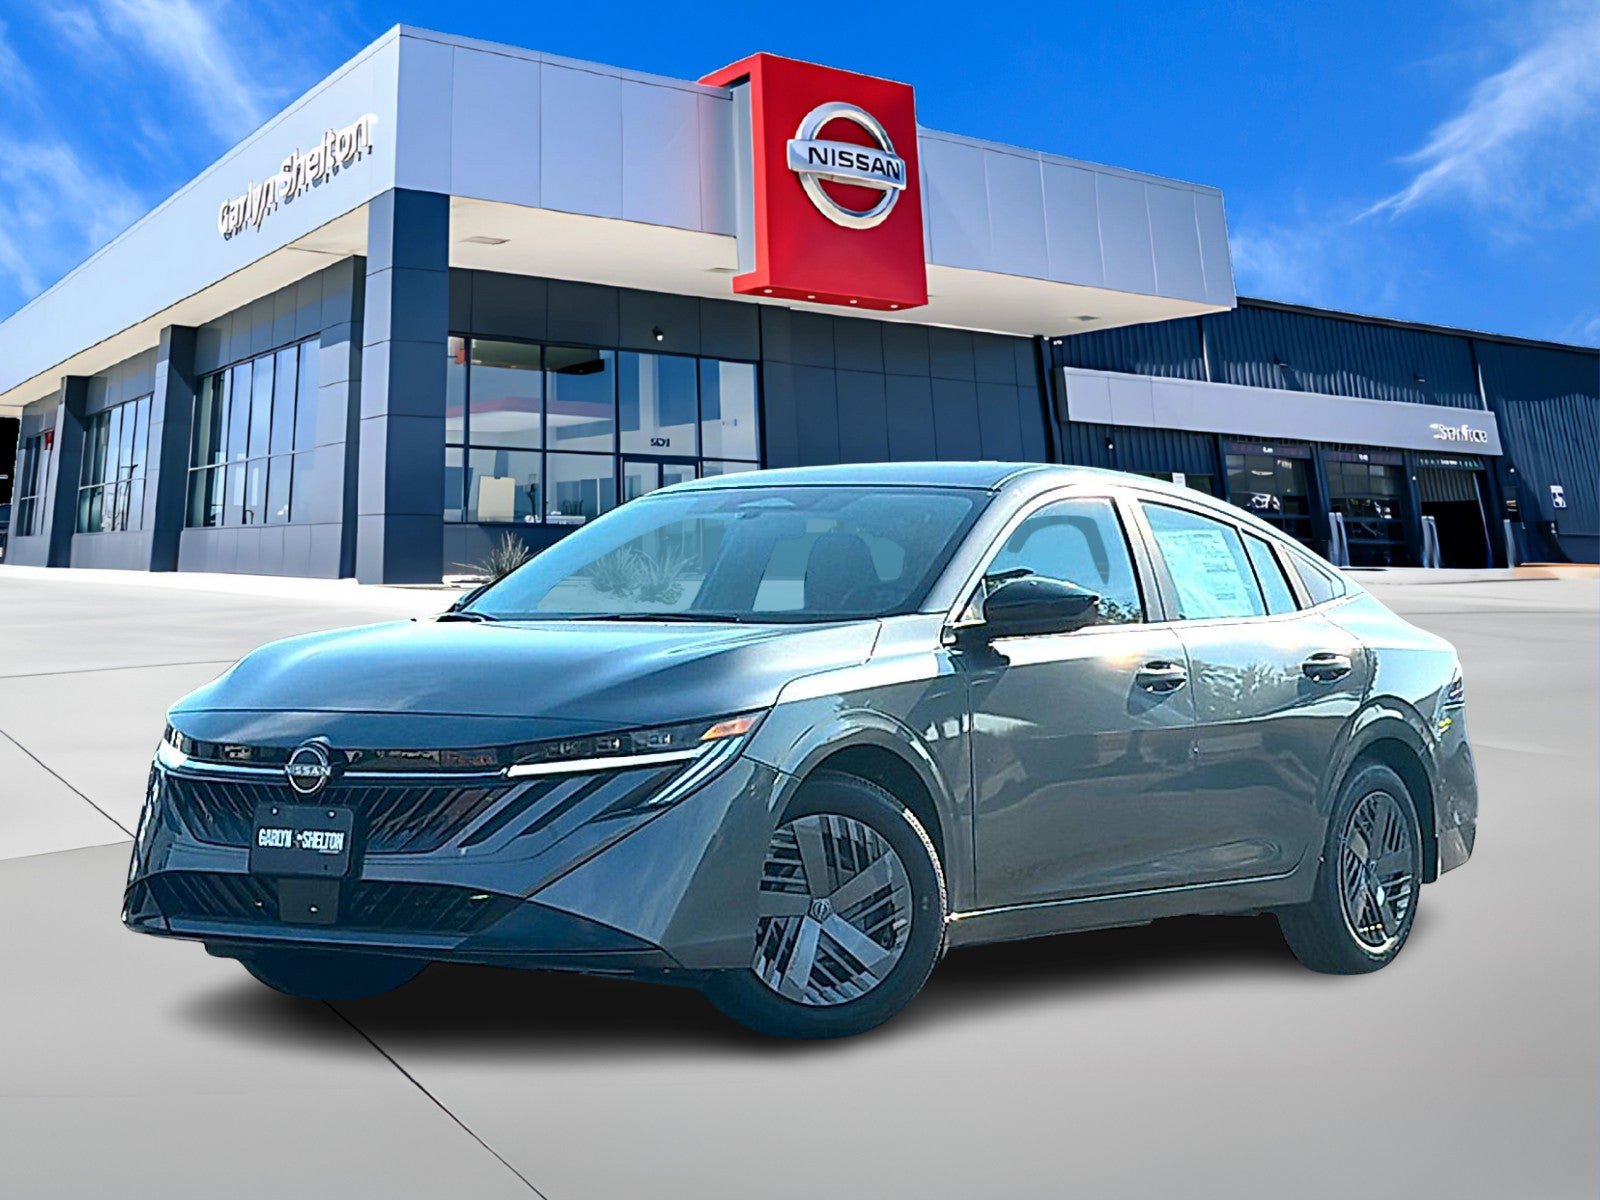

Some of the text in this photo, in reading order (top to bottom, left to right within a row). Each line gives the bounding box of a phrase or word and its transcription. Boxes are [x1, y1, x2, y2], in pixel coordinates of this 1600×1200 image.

[279, 116, 373, 204] Shelton
[808, 146, 900, 181] NISSAN
[301, 830, 345, 851] SHELTON
